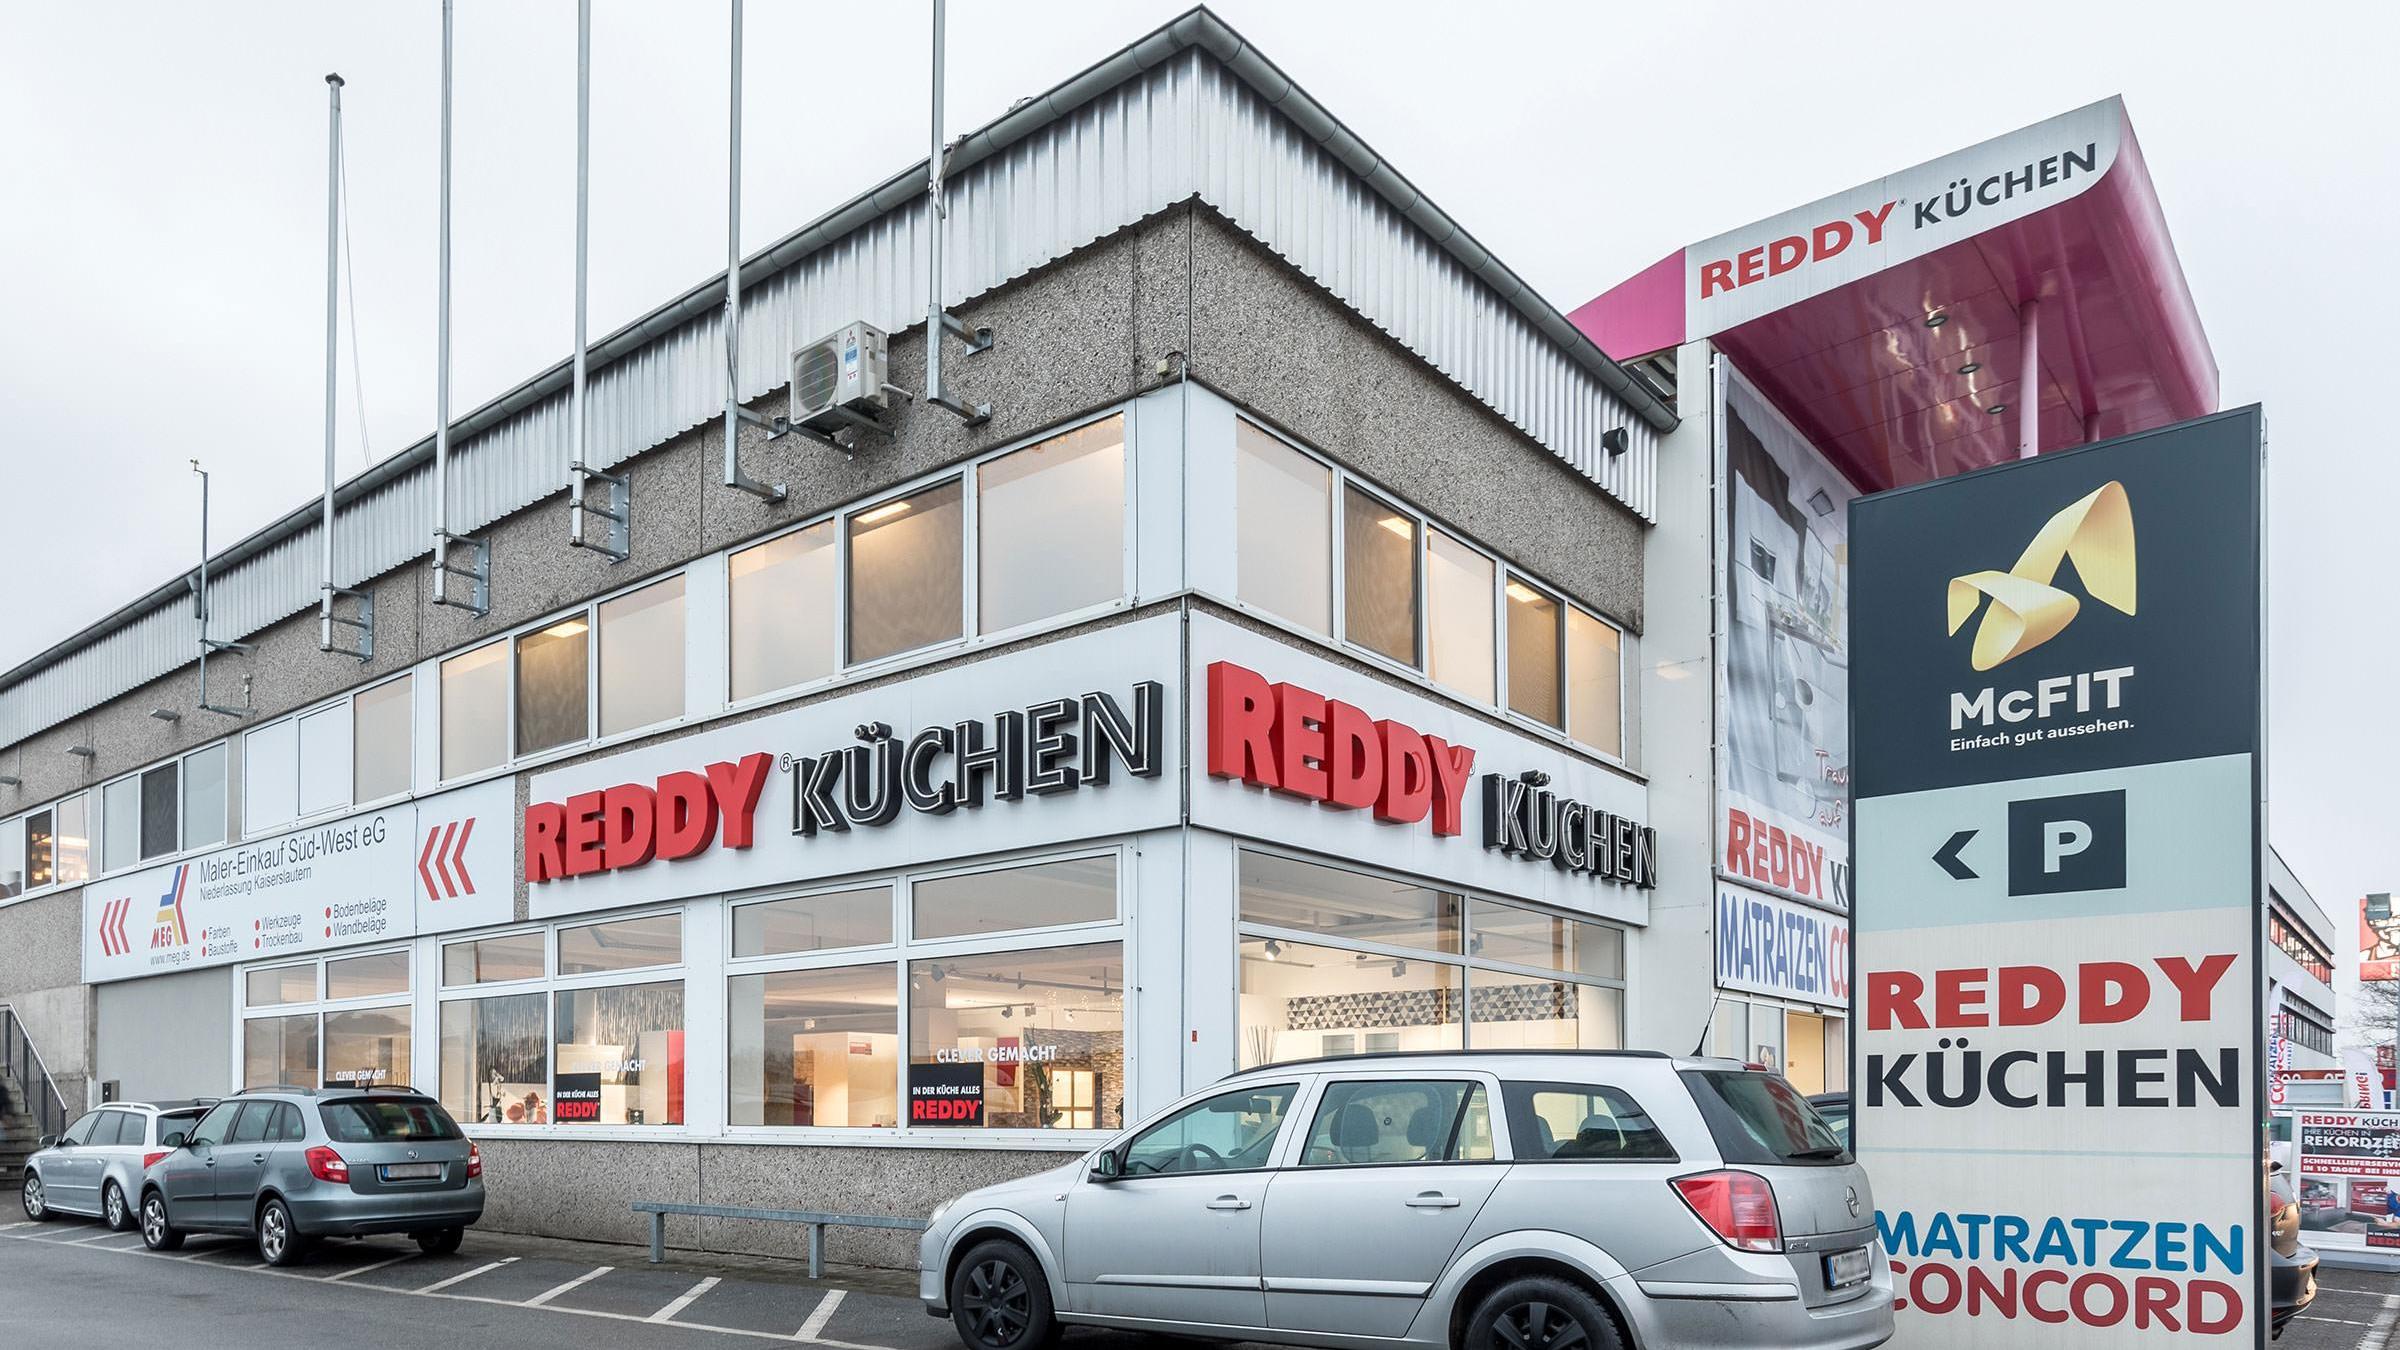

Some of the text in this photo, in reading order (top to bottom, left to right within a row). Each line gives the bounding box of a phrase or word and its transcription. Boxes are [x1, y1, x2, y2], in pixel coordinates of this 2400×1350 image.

[1700, 143, 2096, 300] REDDY KÜCHEN
[1951, 718, 2135, 751] Einfach gut aussehen.
[524, 680, 1163, 883] REDDY KÜCHEN
[1207, 660, 1658, 889] REDDY KÜCHEN
[200, 816, 386, 884] Maler-Einkauf Süd-West eG
[1726, 807, 1824, 901] REDDY
[2043, 820, 2093, 874] P
[200, 866, 312, 902] Niederlassung Kaiserslautern
[333, 899, 387, 919] Bodenbeläge
[262, 912, 302, 931] Werkzeuge
[333, 917, 387, 938] Wandbeläge
[151, 925, 173, 949] MEG
[208, 926, 231, 940] Farben
[262, 930, 303, 949] Trockenbau
[1719, 892, 1827, 995] MATRATZEN
[150, 949, 191, 966] www.meg.de
[208, 940, 239, 957] Baustoffe
[1866, 953, 2239, 1031] REDDY
[936, 1046, 1058, 1063] CLEVER GEMACHT
[335, 1071, 357, 1081] CLEVER
[1866, 1037, 2240, 1108] KÜCHEN
[912, 1084, 981, 1095] IN DER KÜCHE ALLES
[557, 1102, 598, 1118] REDDY
[913, 1100, 979, 1120] REDDY
[2301, 1115, 2358, 1126] REDDY
[2323, 1128, 2359, 1137] KÜCHEN
[1875, 1210, 2244, 1276] MATRATZEN
